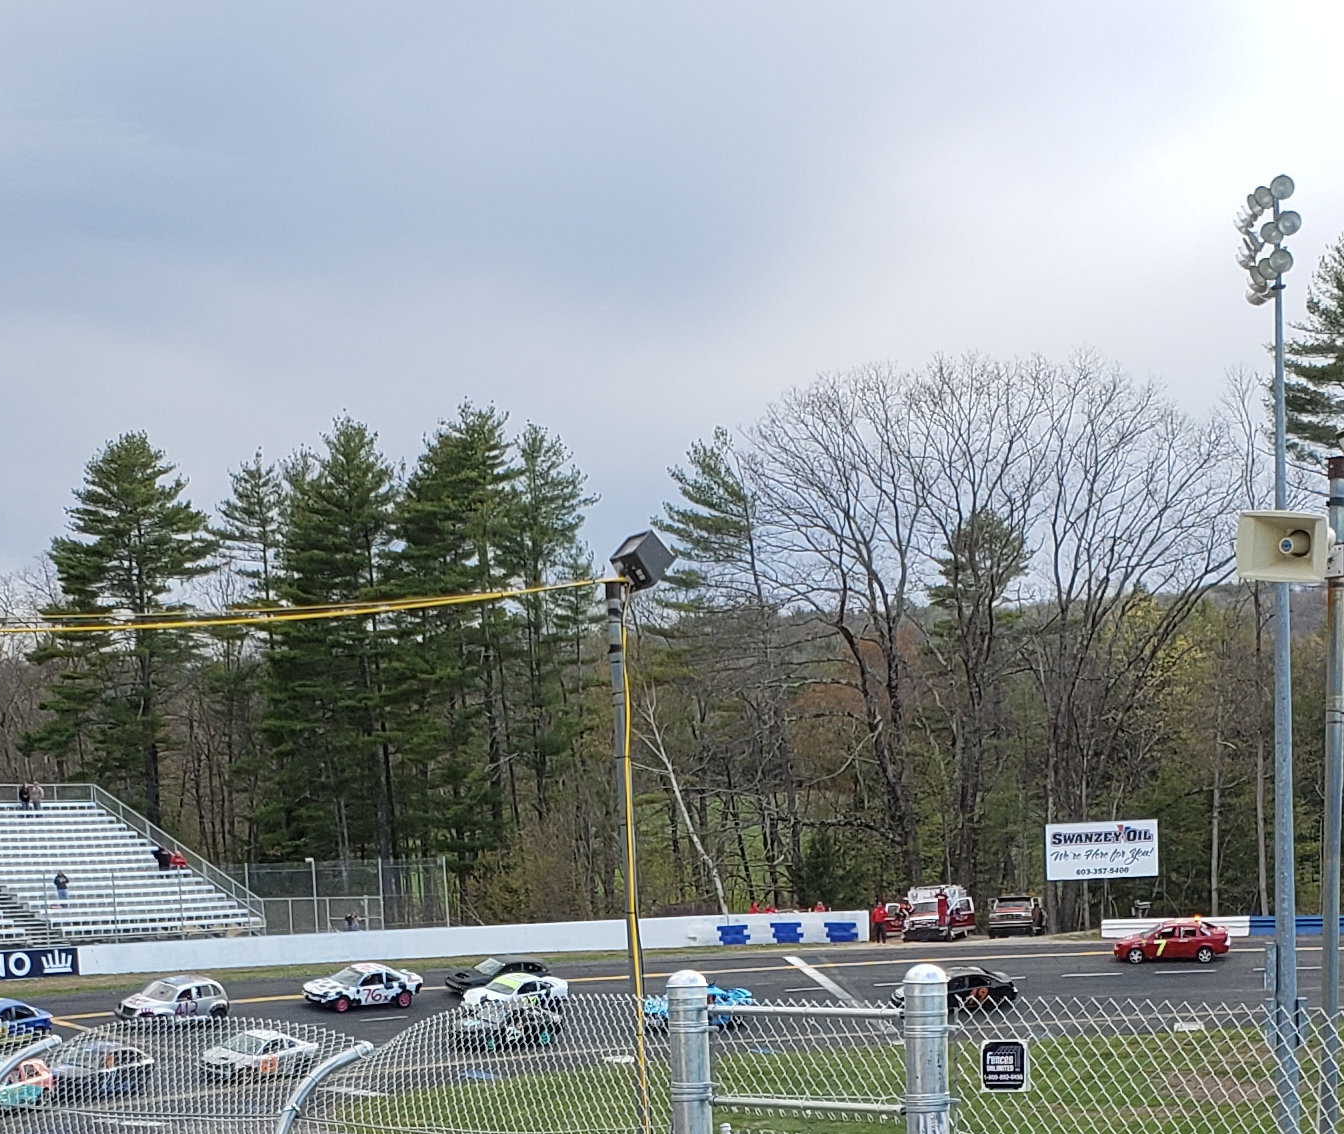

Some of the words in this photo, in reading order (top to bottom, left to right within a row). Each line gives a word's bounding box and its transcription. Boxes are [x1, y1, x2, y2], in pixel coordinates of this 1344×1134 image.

[1051, 832, 1123, 845] SWANZEY
[1126, 829, 1152, 842] OIL
[1050, 851, 1081, 862] We're
[1083, 850, 1108, 861] Here
[1109, 849, 1126, 865] for
[1124, 847, 1154, 865] You!
[1154, 939, 1167, 957] 7
